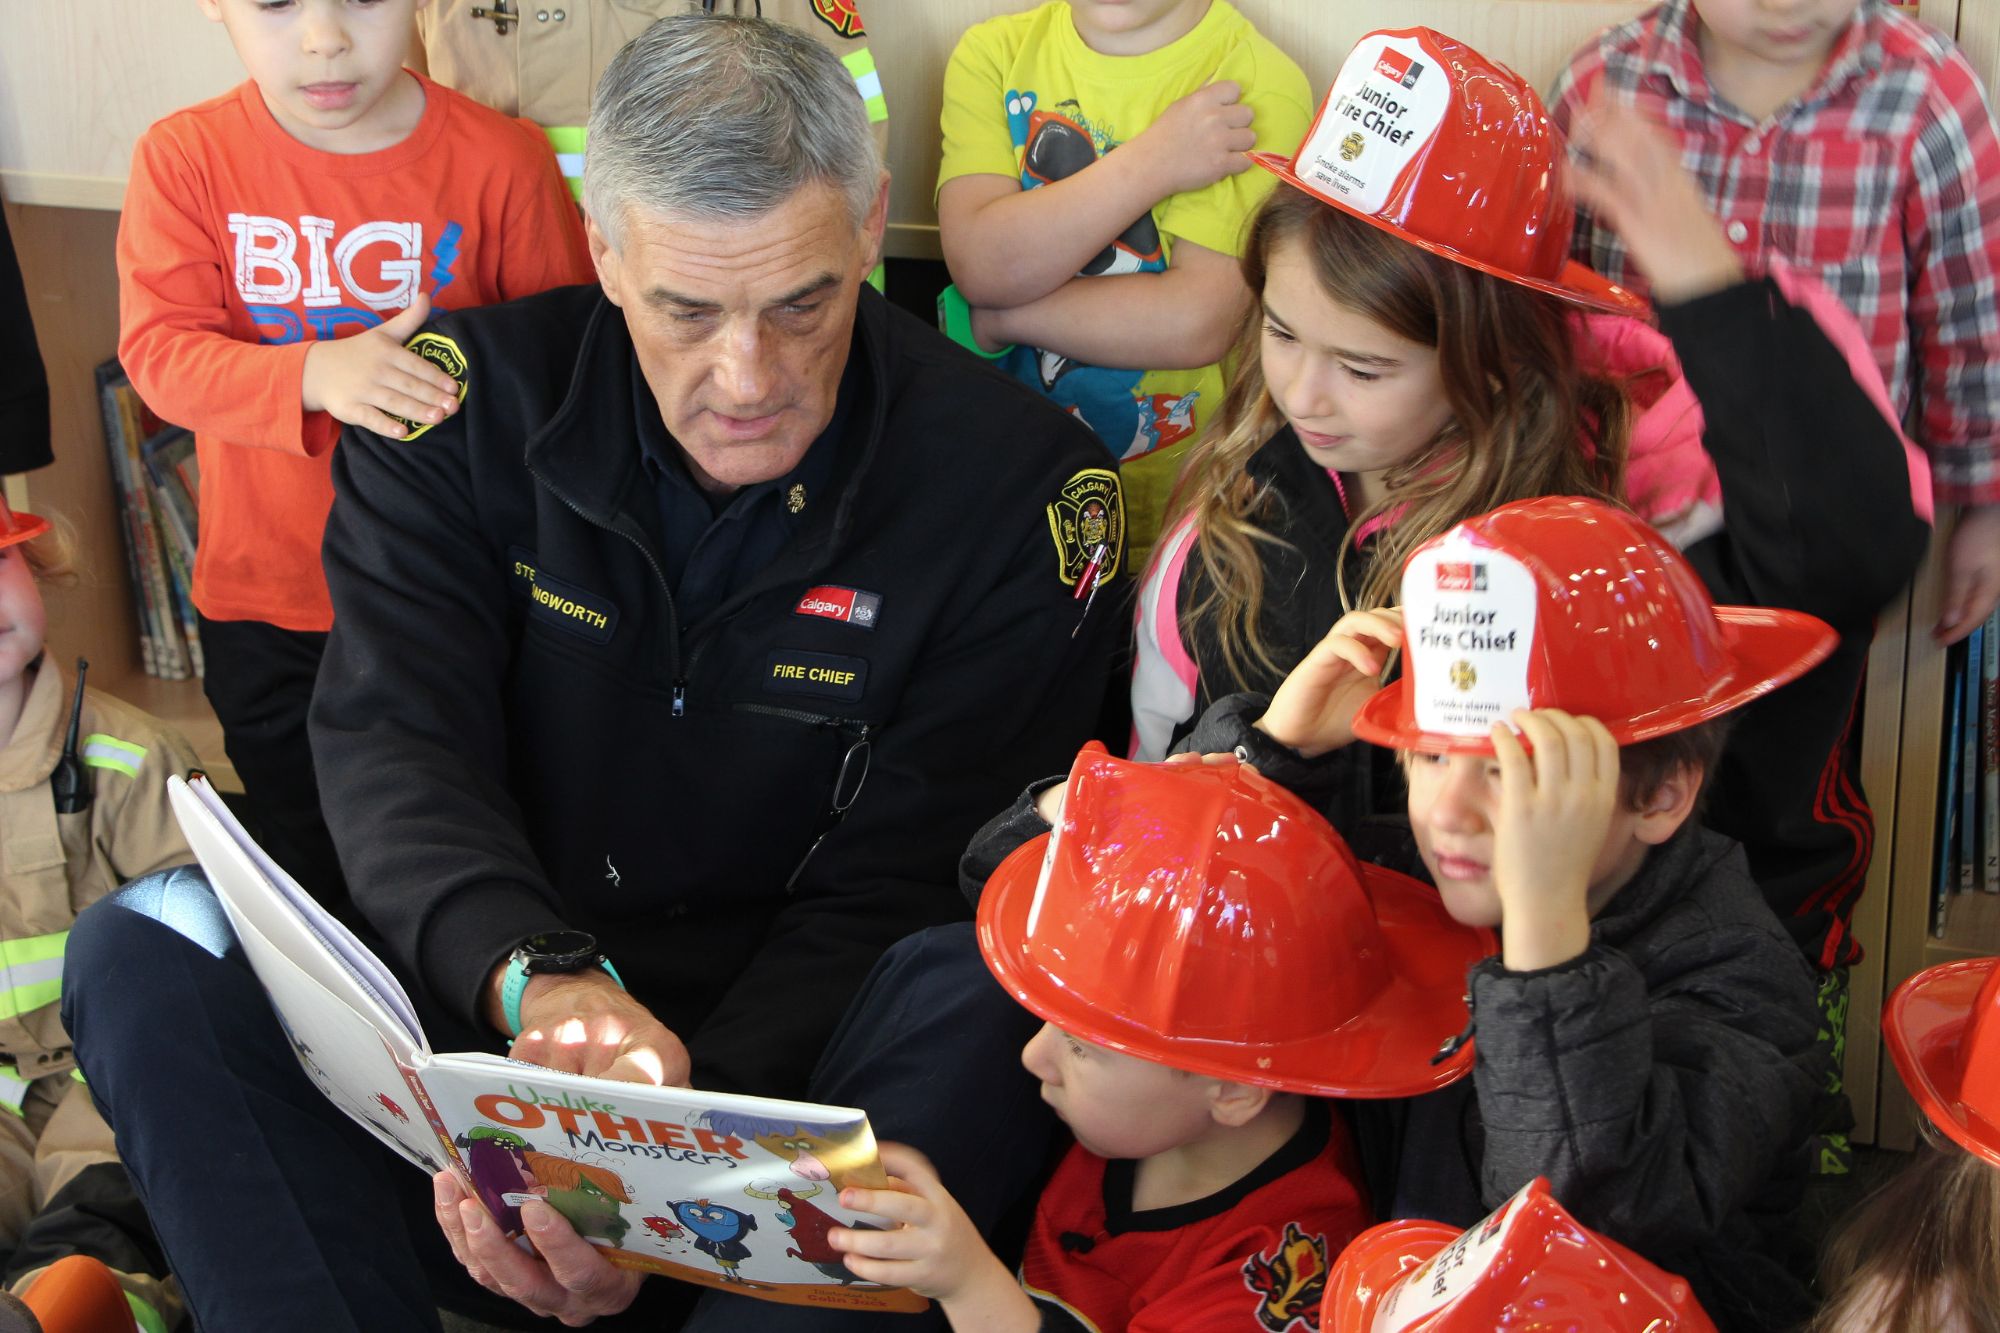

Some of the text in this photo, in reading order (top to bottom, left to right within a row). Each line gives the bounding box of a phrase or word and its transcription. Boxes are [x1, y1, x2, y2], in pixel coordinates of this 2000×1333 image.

[1356, 81, 1408, 118] Junior
[1335, 95, 1414, 147] Fire Chief
[1314, 155, 1366, 189] Smoke alarms
[1315, 170, 1350, 195] save lives
[228, 213, 422, 310] BIG
[425, 348, 456, 375] CALGARY
[1071, 482, 1108, 499] CALGARY
[800, 599, 846, 617] Calgary
[1432, 603, 1497, 625] Junior
[1420, 627, 1517, 650] Fire Chief
[773, 665, 855, 685] FIRE CHIEF
[508, 1084, 621, 1116] Unlike
[474, 1093, 750, 1160] OTHER
[566, 1128, 739, 1168] Monsters
[807, 1294, 848, 1304] Colin
